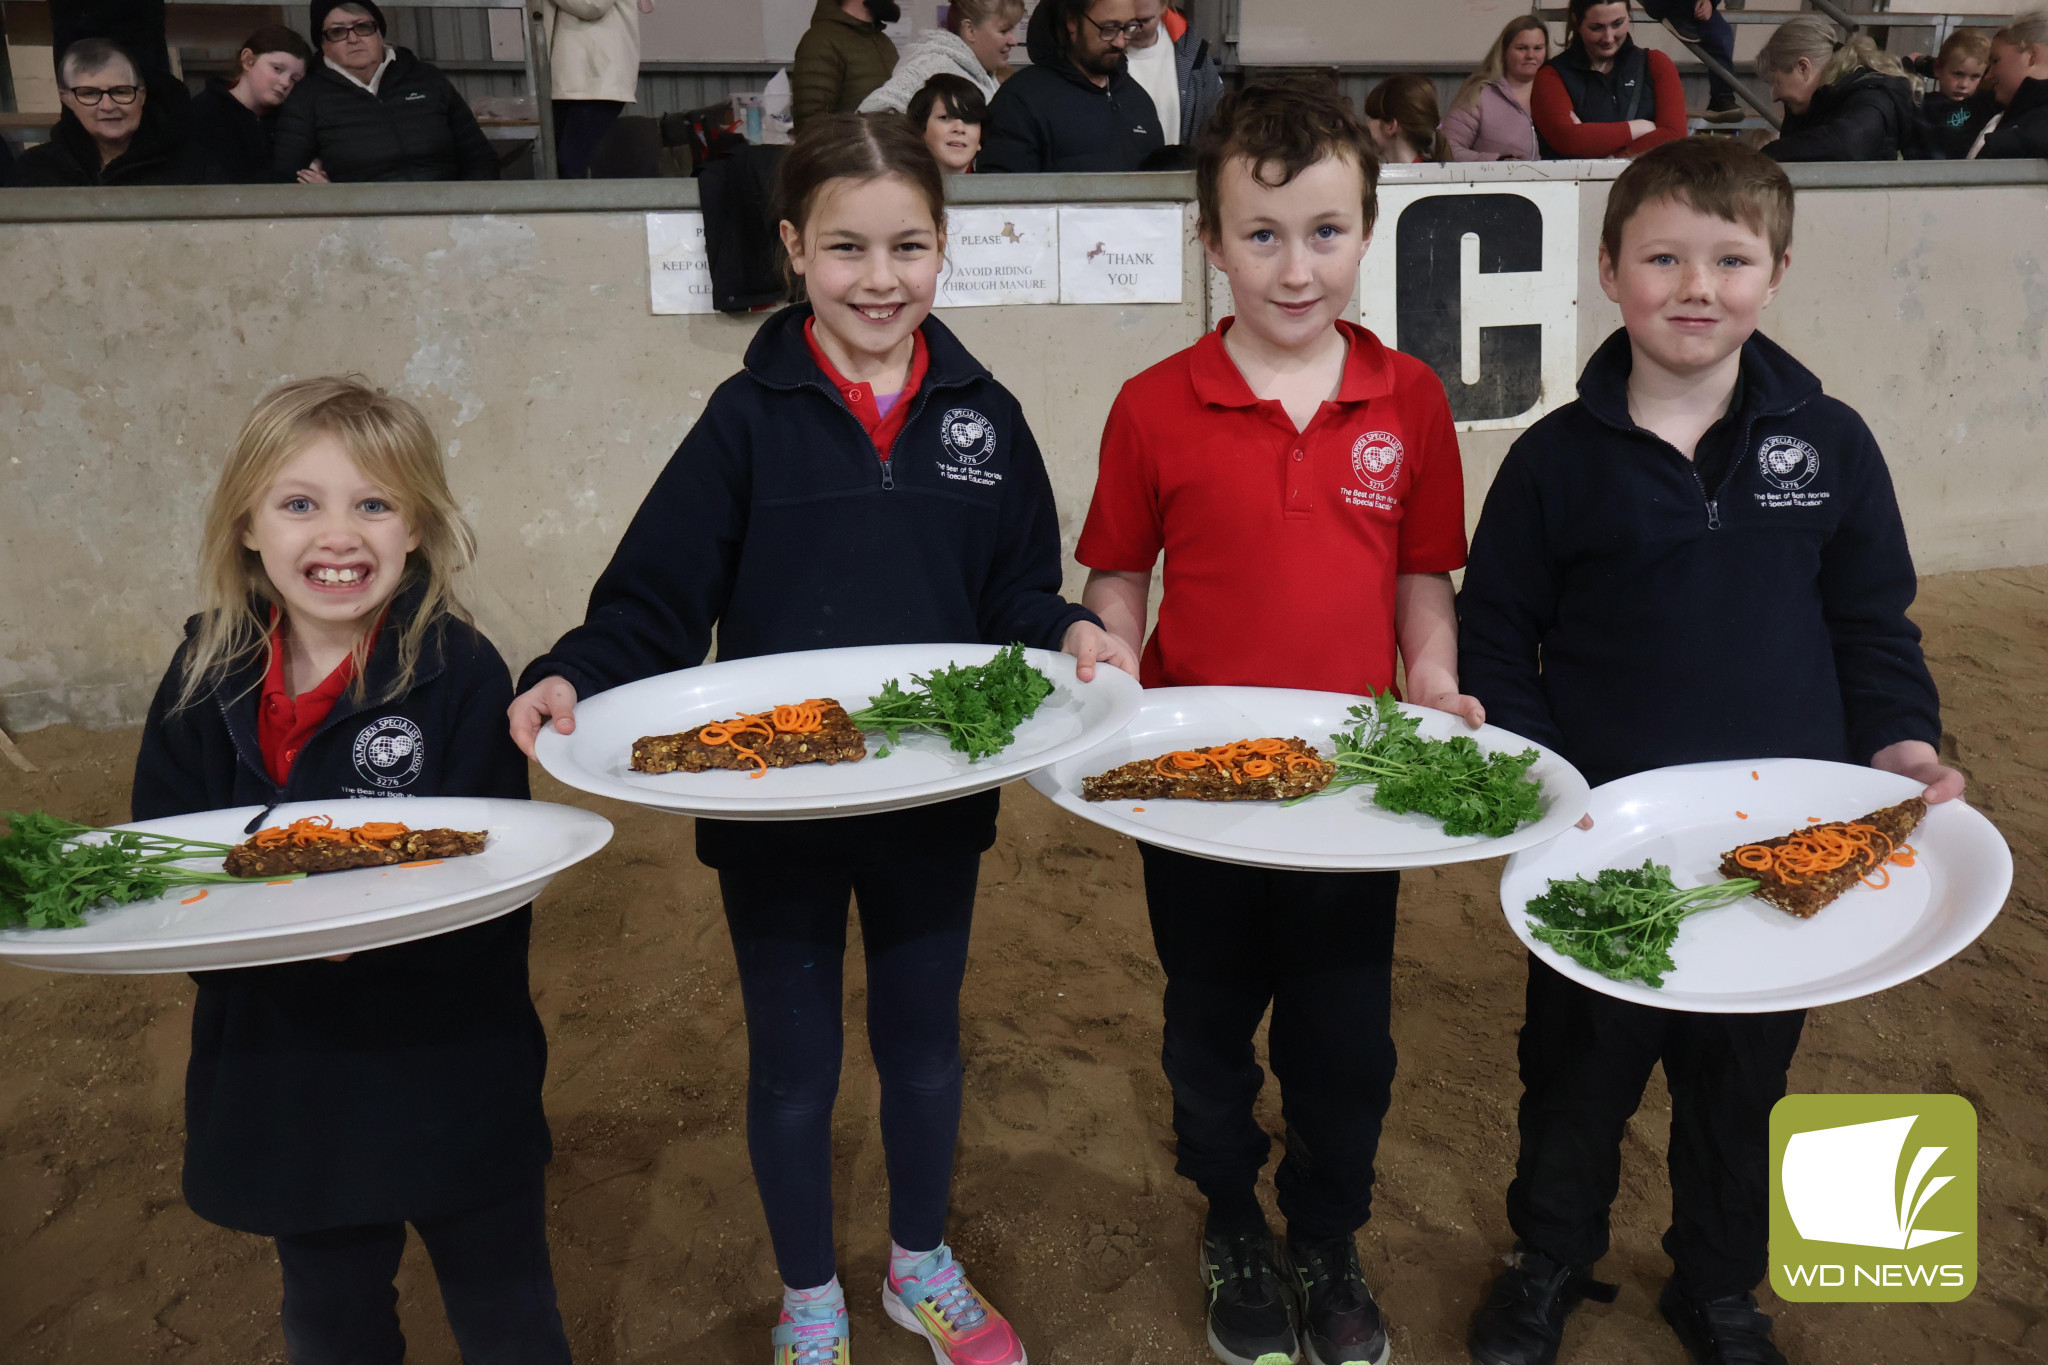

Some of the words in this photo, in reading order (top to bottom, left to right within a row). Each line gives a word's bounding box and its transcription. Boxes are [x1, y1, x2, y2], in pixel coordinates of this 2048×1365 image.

[961, 235, 1002, 245] PLEASE
[1106, 253, 1154, 265] THANK
[663, 261, 692, 270] KEEP
[956, 267, 992, 277] AVOID
[994, 266, 1032, 276] RIDING
[1108, 273, 1138, 285] YOU
[689, 284, 712, 294] CLE
[945, 281, 997, 291] THROUGH
[999, 280, 1046, 290] MANURE
[1396, 193, 1542, 422] C
[1369, 481, 1384, 490] 5276
[1340, 487, 1352, 496] The
[1353, 489, 1368, 498] Best
[1352, 497, 1374, 507] Special
[356, 725, 378, 766] HAMPDEN
[379, 719, 420, 741] SPECIALIST
[411, 741, 423, 774] SCHOOL
[376, 777, 399, 786] 5276
[341, 786, 356, 794] The
[357, 787, 375, 795] Best
